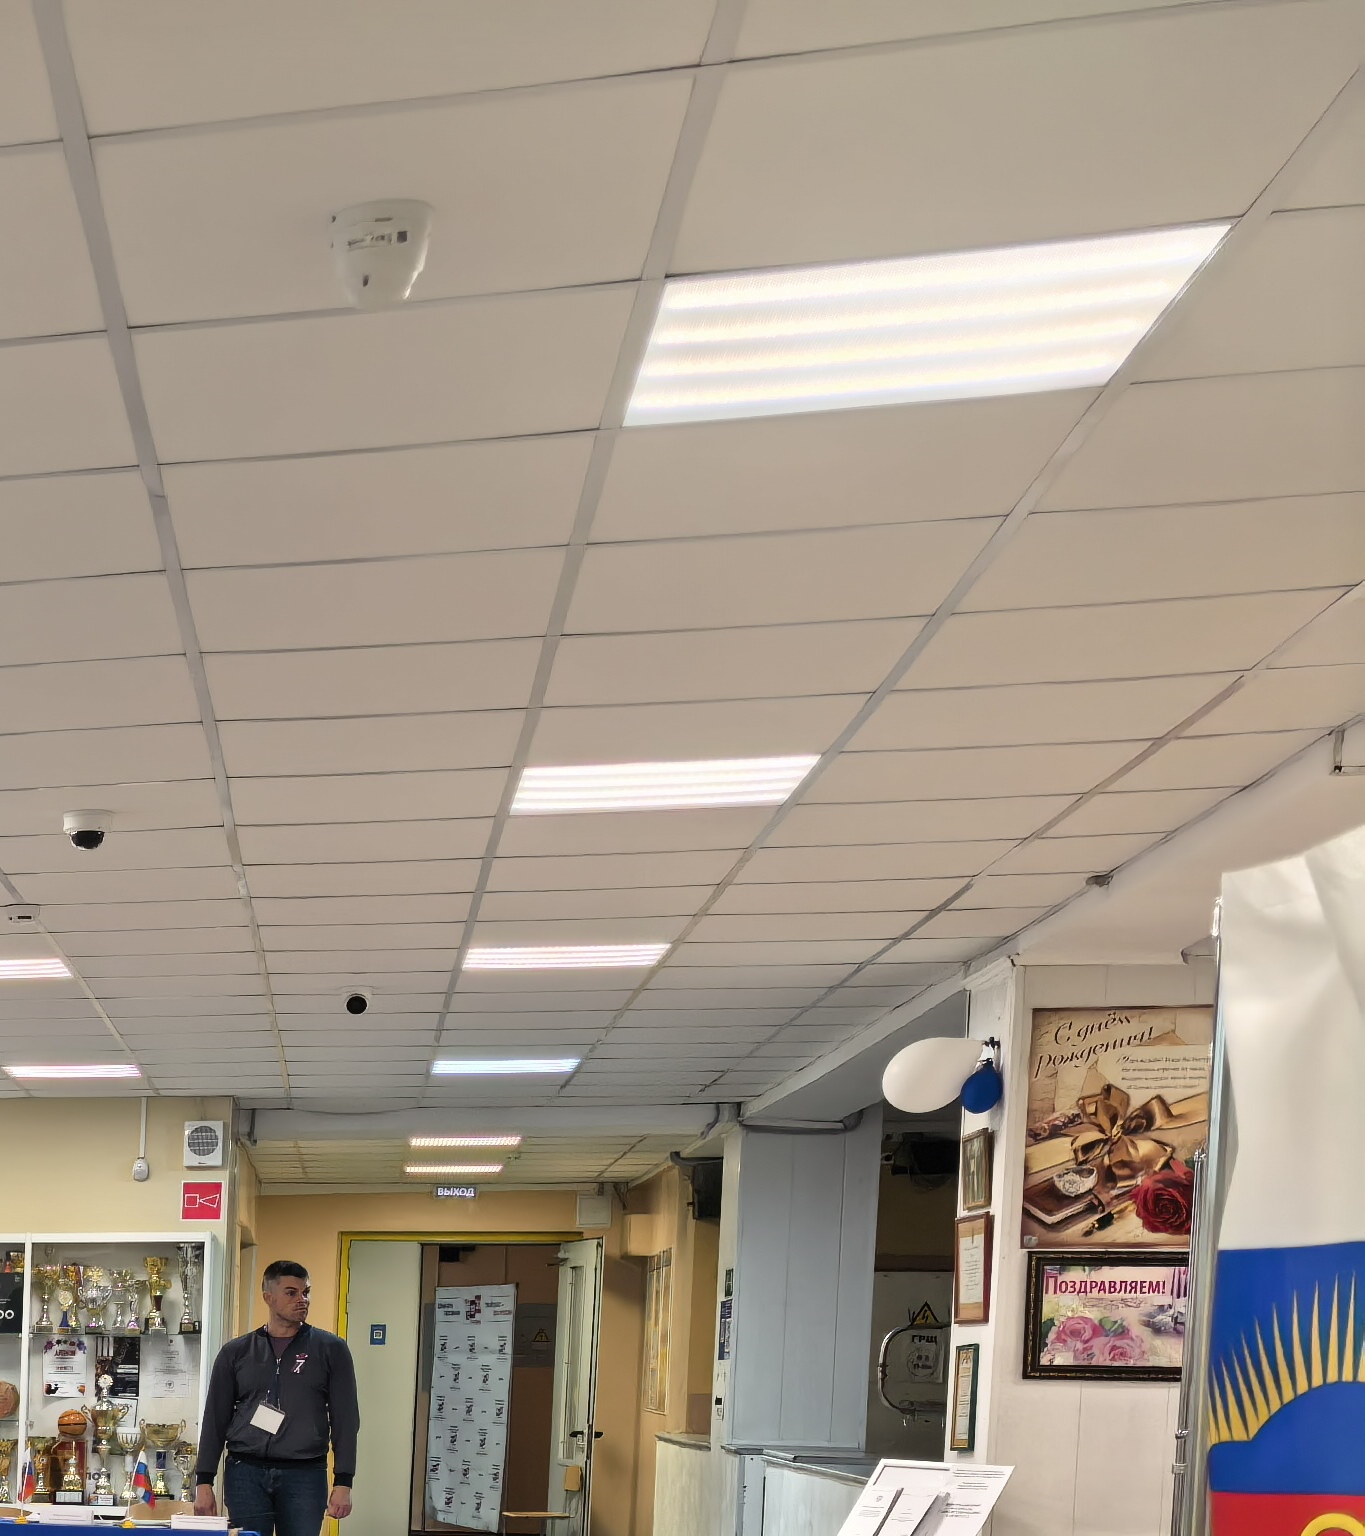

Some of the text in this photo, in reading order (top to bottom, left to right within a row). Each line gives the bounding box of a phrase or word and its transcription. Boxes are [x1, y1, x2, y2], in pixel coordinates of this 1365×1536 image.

[1054, 1011, 1131, 1047] С днём
[1034, 1026, 1154, 1079] рождения!
[437, 1187, 475, 1197] ВЫХОД
[911, 1334, 938, 1345] ГРЩ
